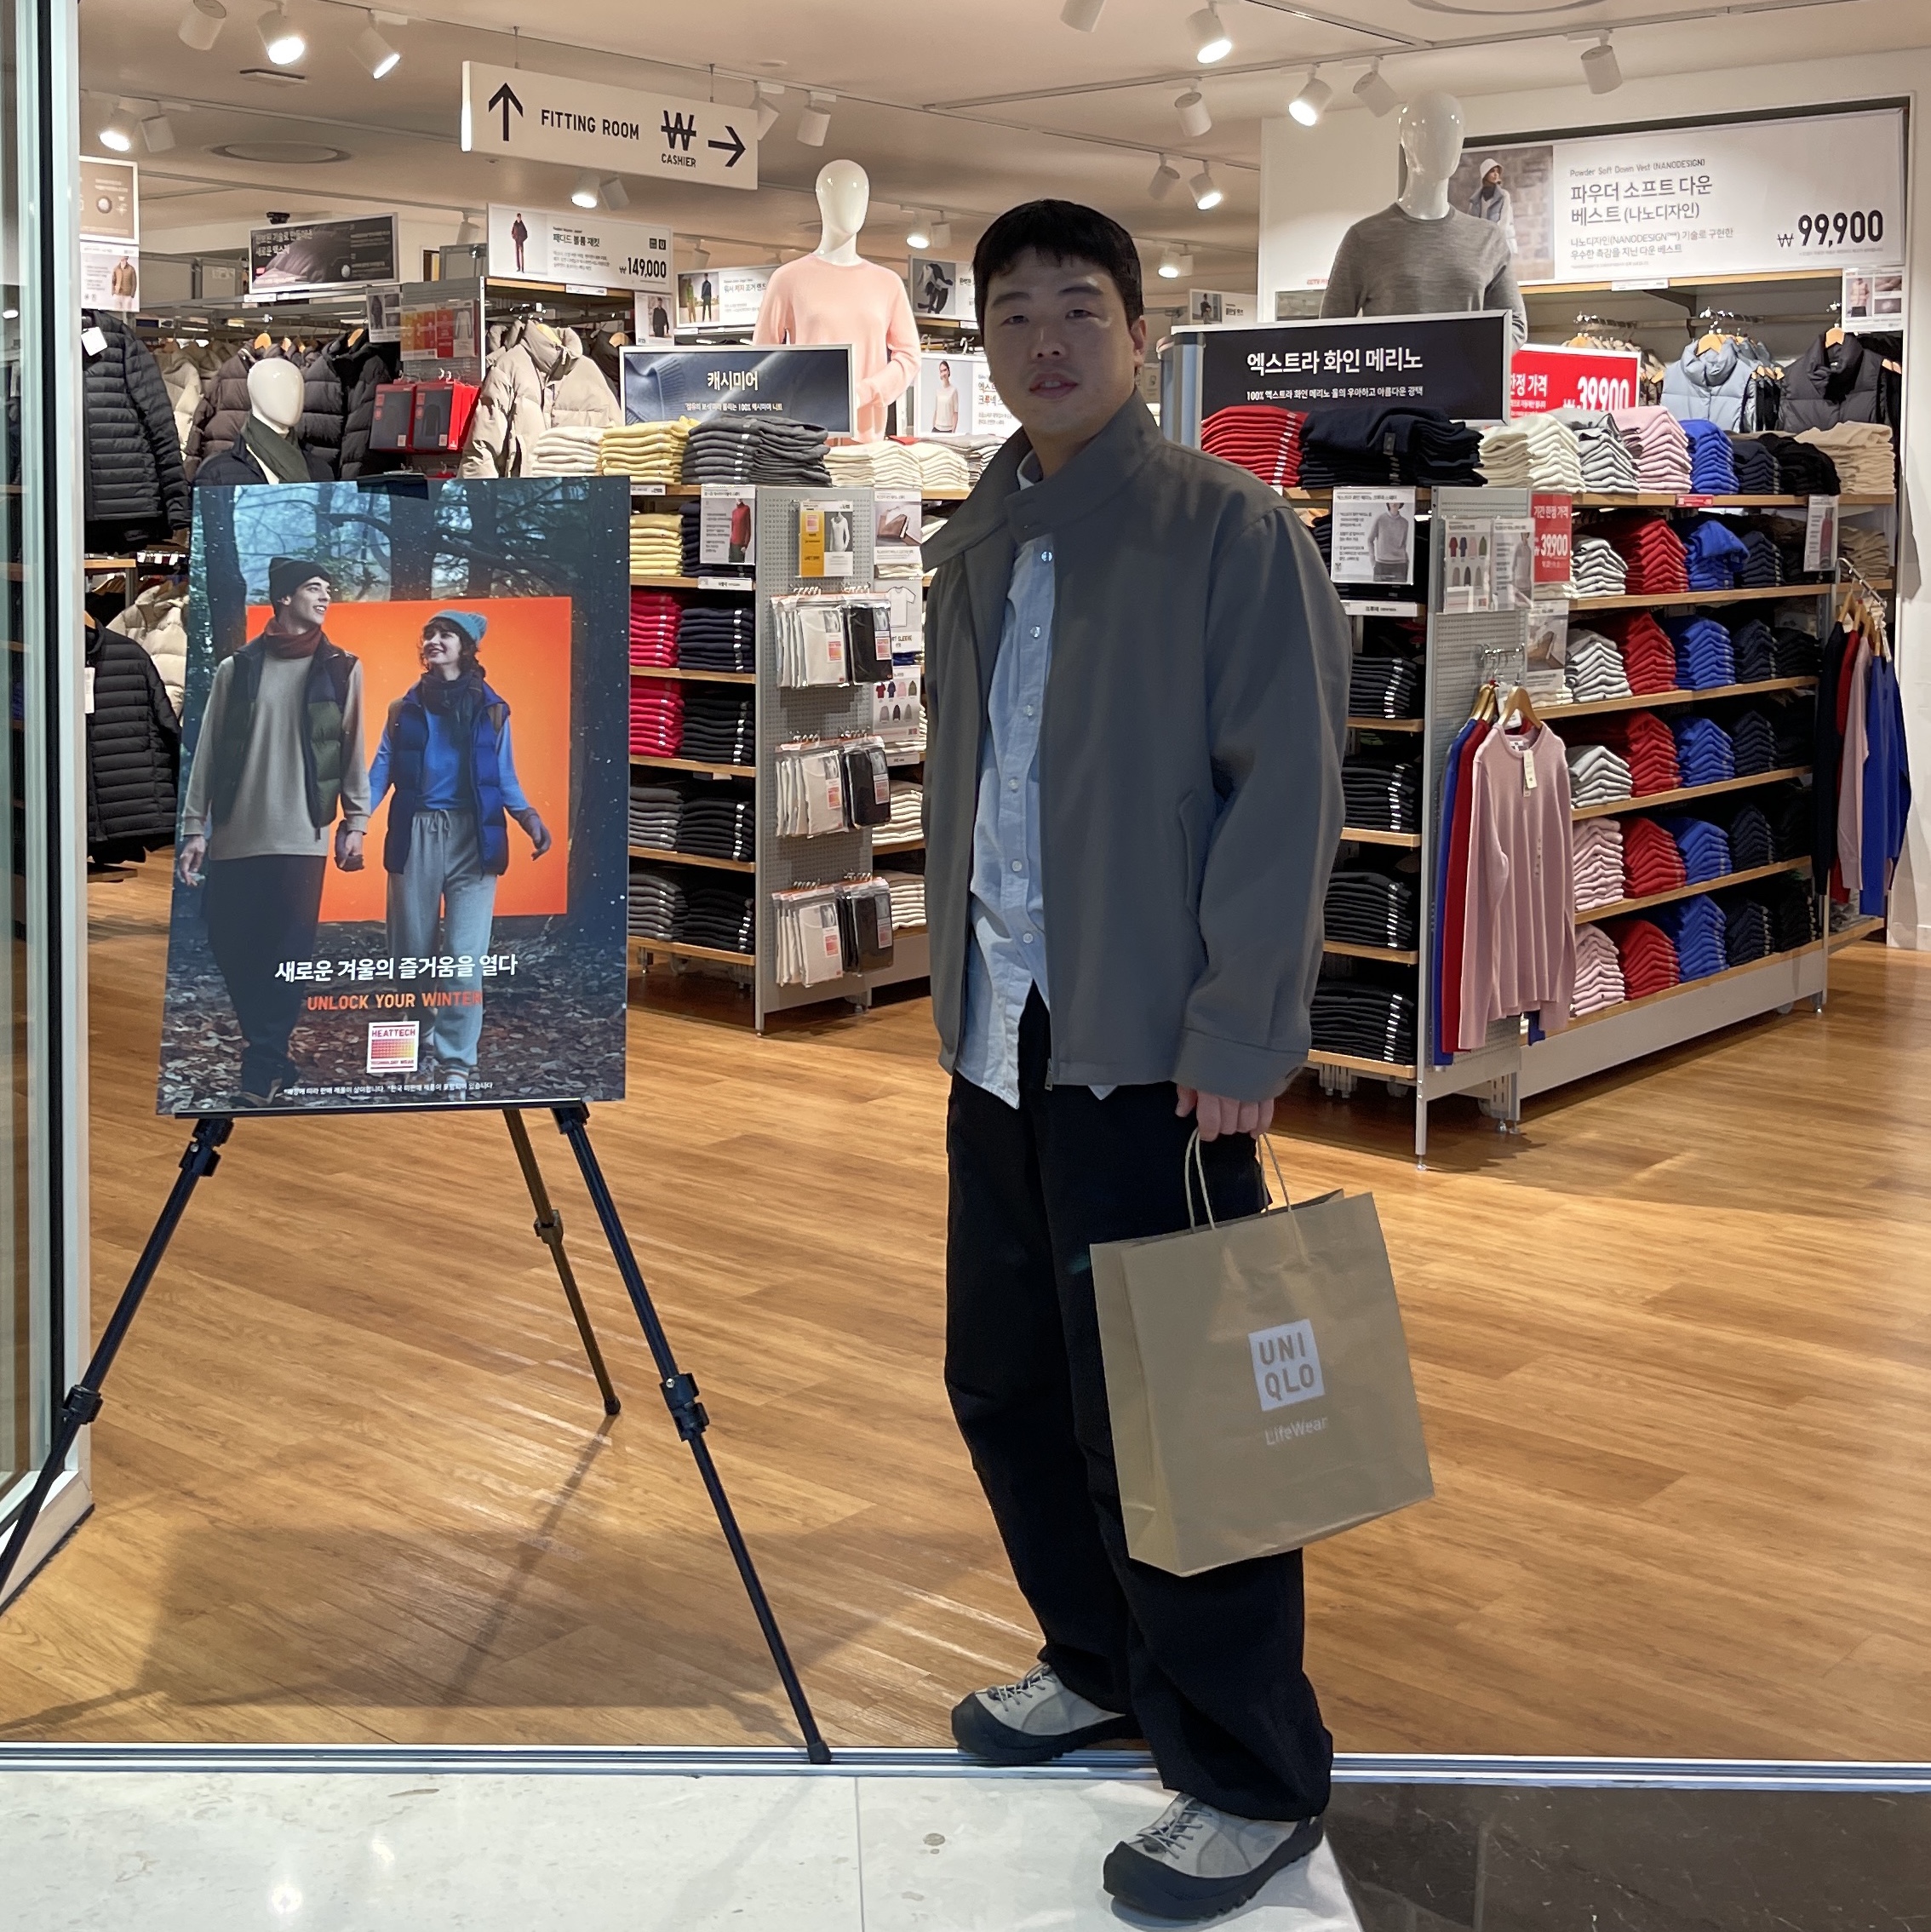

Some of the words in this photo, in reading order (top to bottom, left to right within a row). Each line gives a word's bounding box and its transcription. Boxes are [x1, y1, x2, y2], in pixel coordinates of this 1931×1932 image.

[541, 109, 596, 133] FITTING
[602, 118, 639, 140] ROOM
[661, 153, 696, 168] CASHIER
[1570, 169, 1595, 177] Powder
[1598, 166, 1612, 175] Soft
[1615, 165, 1634, 174] Down
[1636, 163, 1650, 172] Vest
[1571, 181, 1619, 204] 파우더
[1623, 179, 1676, 198] 소프트
[1679, 175, 1712, 196] 다운
[1571, 205, 1621, 226] 베스트
[1624, 202, 1699, 223] (나노디자인)
[1682, 229, 1707, 241] 기술로
[1571, 249, 1594, 260] 우수한
[1622, 246, 1638, 256] 지닌
[1640, 245, 1655, 255] 다운
[1658, 244, 1682, 254] 베스트
[1247, 350, 1320, 376] 엑스트라
[1323, 348, 1360, 374] 화인
[1366, 347, 1423, 372] 메리노
[707, 370, 759, 391] 캐시미어
[1527, 374, 1548, 397] 가격
[1246, 390, 1264, 401] 100%
[1265, 388, 1292, 399] 엑스트라
[1293, 388, 1309, 399] 화인
[1309, 387, 1331, 398] 메리노
[1347, 387, 1376, 398] 우아하고
[1377, 387, 1407, 398] 아름다운
[274, 960, 334, 983] 새로운
[337, 958, 394, 981] 겨울의
[398, 955, 475, 979] 즐거움을
[479, 954, 518, 977] 열다
[307, 995, 368, 1011] UNLOCK
[375, 993, 415, 1009] YOUR
[421, 990, 483, 1007] WINTER
[371, 1029, 415, 1037] HEATTECH
[1258, 1332, 1306, 1365] UNI
[1264, 1363, 1315, 1401] QLO
[1264, 1416, 1328, 1446] LifeWear
